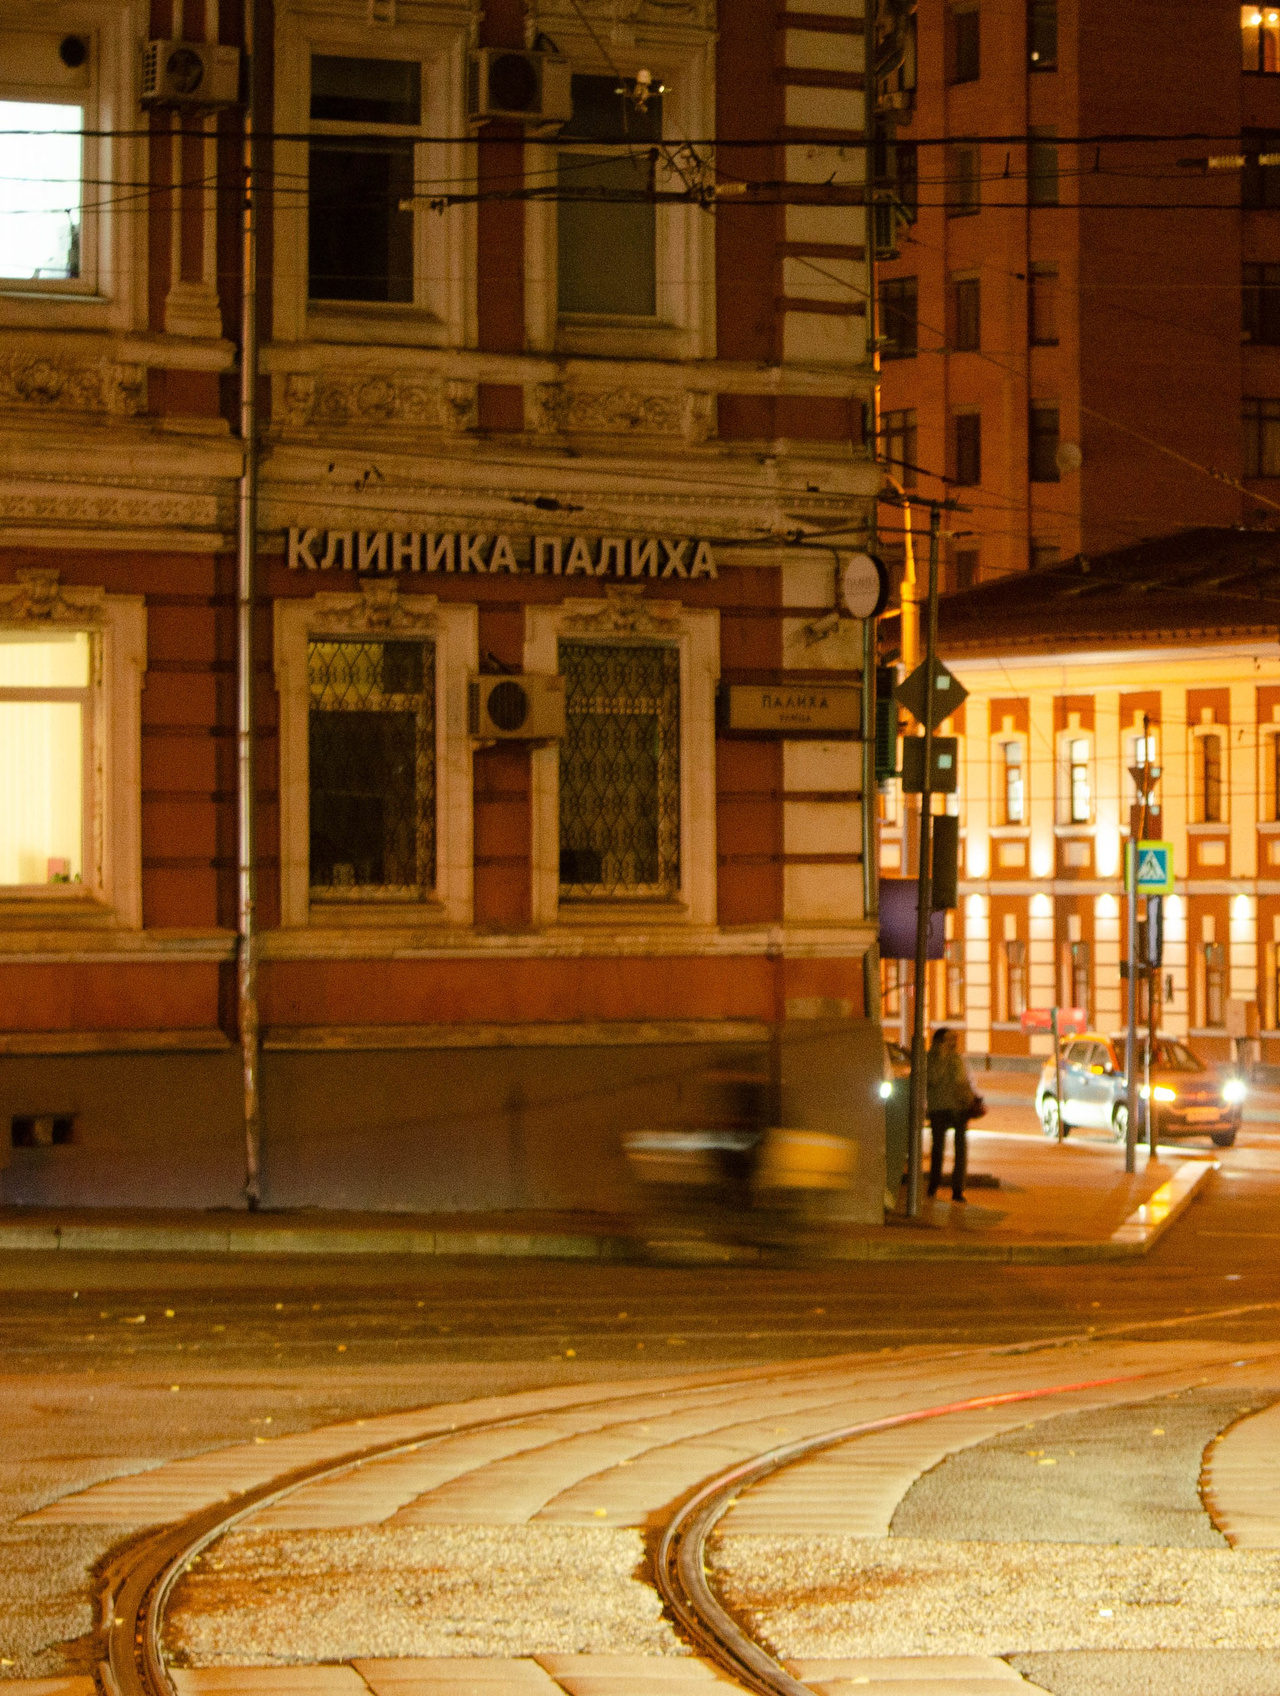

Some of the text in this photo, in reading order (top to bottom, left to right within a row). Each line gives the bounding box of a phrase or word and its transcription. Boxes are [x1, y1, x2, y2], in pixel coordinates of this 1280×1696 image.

[286, 526, 719, 579] КЛИНИКА ПАЛИХА
[762, 694, 829, 709] ПАЛИХА
